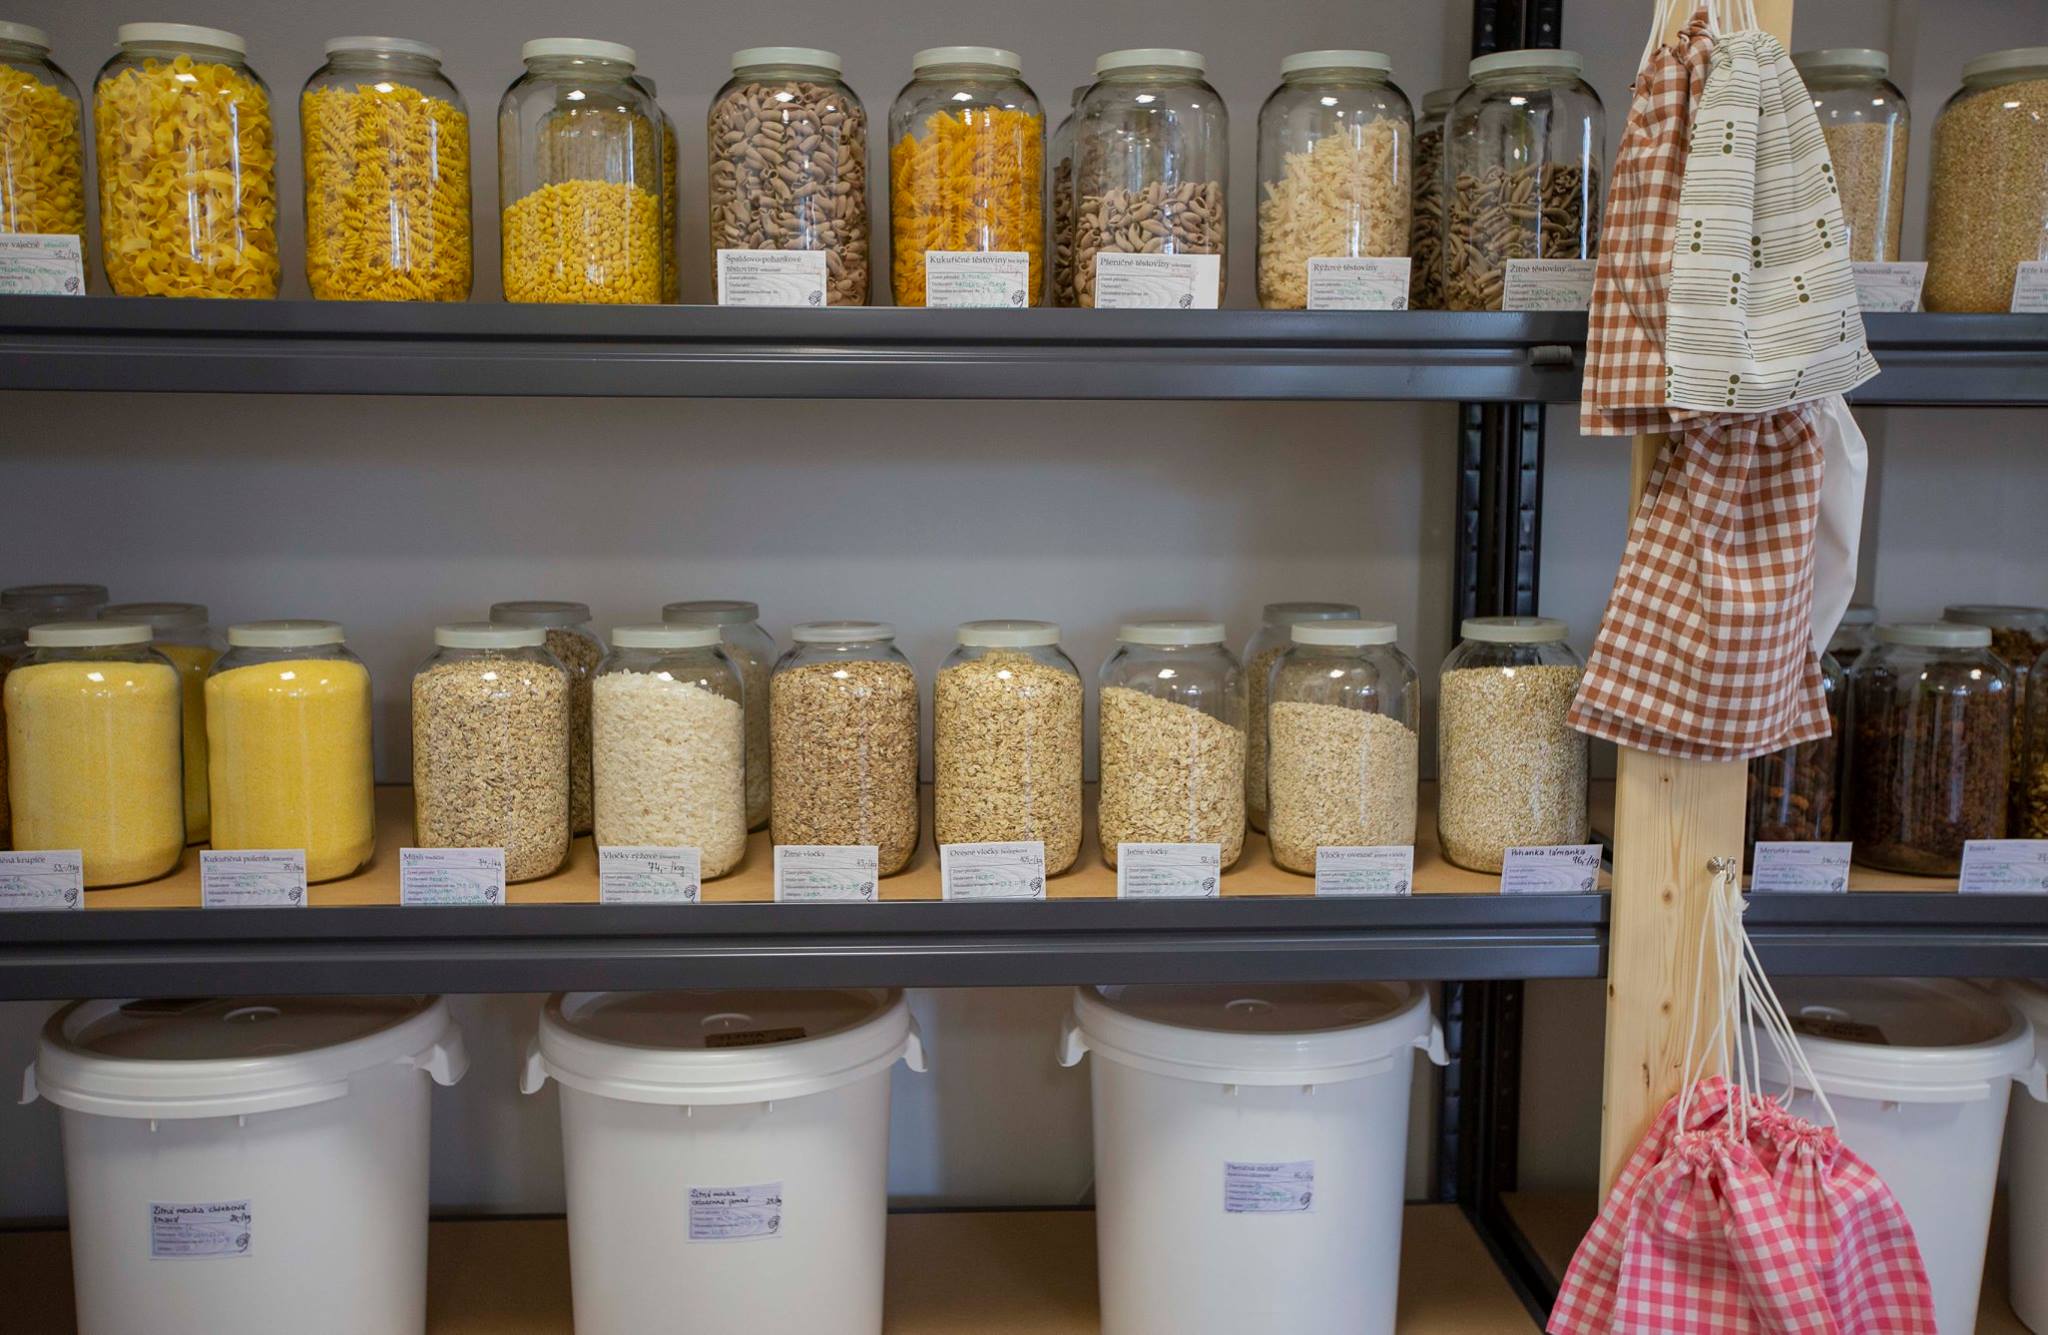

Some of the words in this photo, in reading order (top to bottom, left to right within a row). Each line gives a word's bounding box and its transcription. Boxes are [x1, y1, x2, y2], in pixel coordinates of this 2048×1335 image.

[930, 255, 971, 264] Kukuřičné
[972, 255, 1008, 265] těstoviny
[1135, 259, 1169, 269] těstoviny
[1313, 263, 1341, 272] Rýžové
[1343, 263, 1378, 272] těstoviny
[1510, 263, 1530, 272] Žitné
[1531, 264, 1567, 272] těstoviny
[603, 851, 629, 860] Vločky
[977, 847, 998, 856] vločky
[1146, 848, 1168, 856] vločky
[1320, 851, 1345, 860] Vločky
[1511, 848, 1545, 857] Pohanka
[1548, 847, 1586, 857] lámanka
